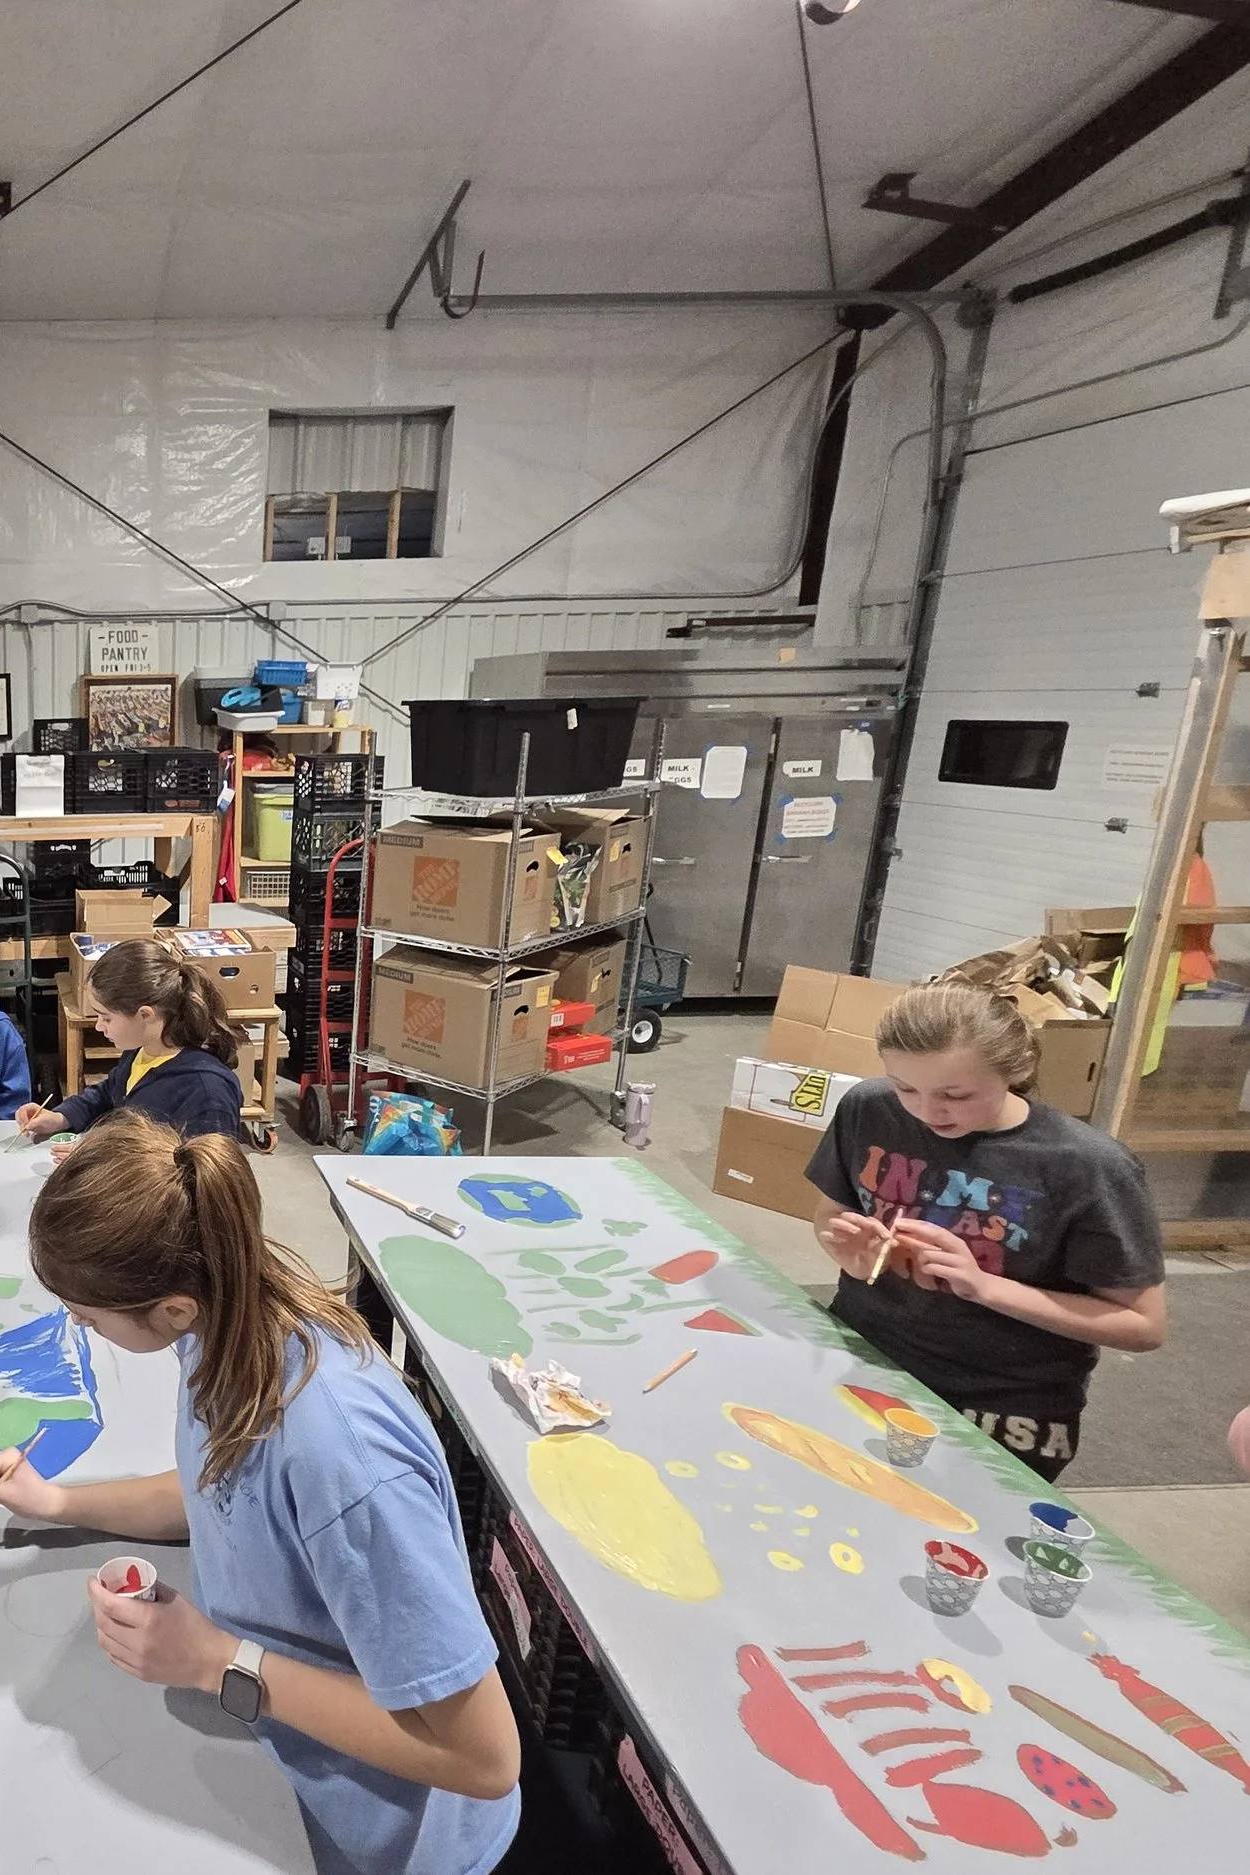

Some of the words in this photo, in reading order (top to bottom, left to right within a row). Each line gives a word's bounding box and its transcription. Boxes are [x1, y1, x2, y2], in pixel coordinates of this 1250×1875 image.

[108, 629, 139, 644] FOOD
[101, 646, 148, 661] PANTRY
[100, 664, 119, 673] OPEN
[667, 764, 690, 773] MILK
[791, 766, 815, 774] MILK
[381, 835, 421, 847] MEDIUM
[377, 965, 412, 983] MEDIUM
[794, 1074, 827, 1110] UITS
